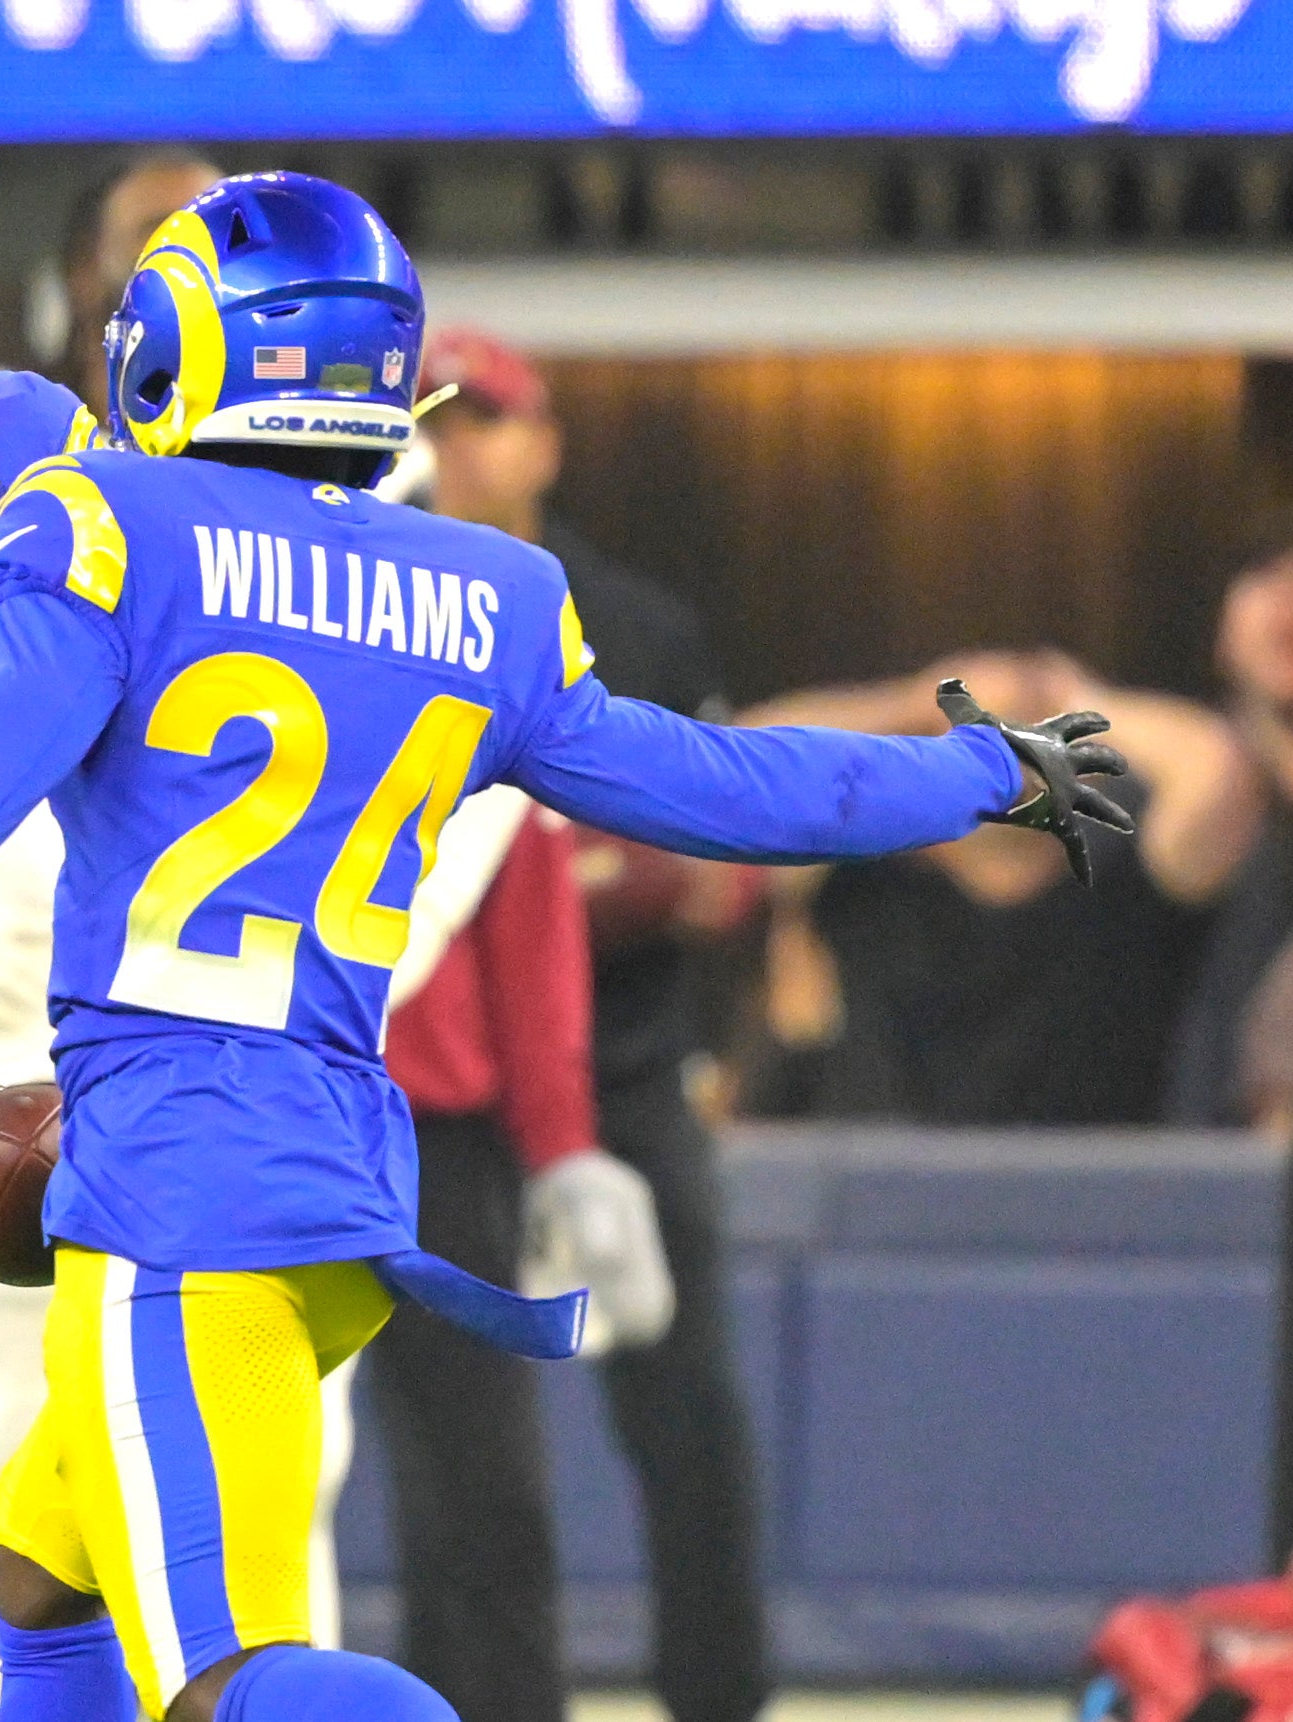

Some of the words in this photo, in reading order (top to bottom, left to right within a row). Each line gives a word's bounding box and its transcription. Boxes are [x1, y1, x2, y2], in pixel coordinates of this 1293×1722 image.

[249, 416, 305, 431] LOS
[309, 418, 410, 441] ANGELES
[194, 525, 499, 672] WILLIAMS
[107, 651, 494, 1031] 24
